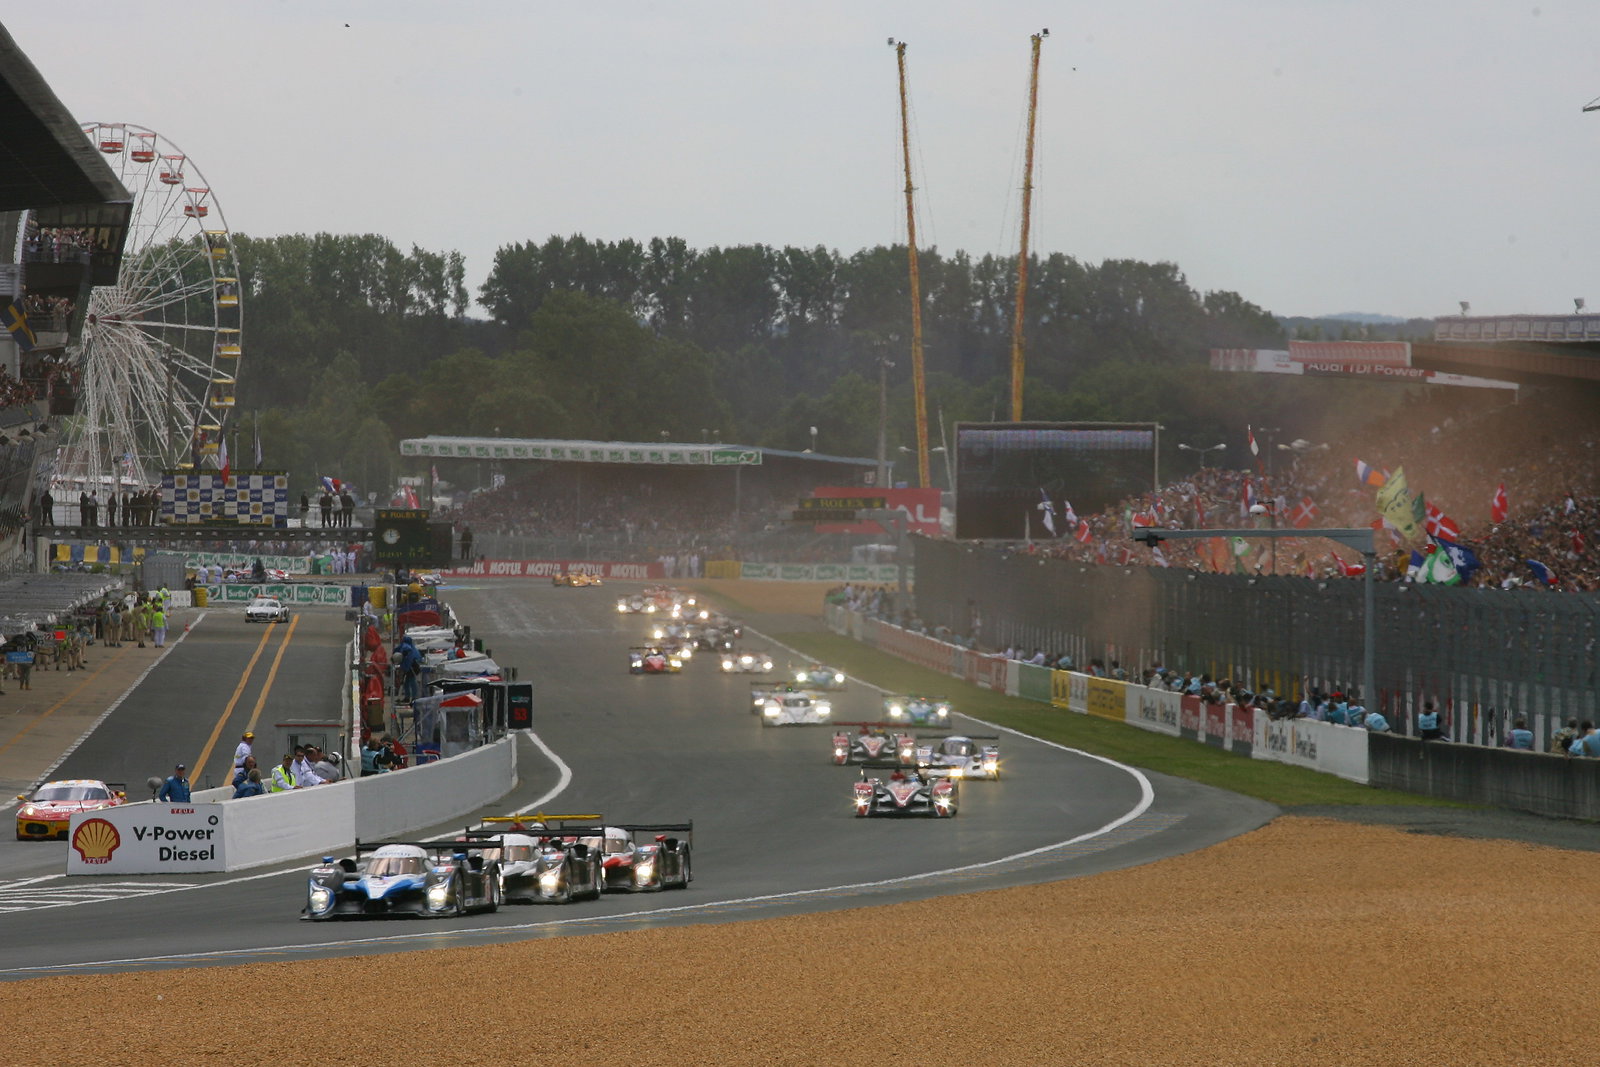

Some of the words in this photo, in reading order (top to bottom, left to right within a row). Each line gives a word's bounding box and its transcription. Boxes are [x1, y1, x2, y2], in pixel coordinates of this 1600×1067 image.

[1307, 362, 1344, 373] Audi
[1375, 365, 1424, 377] Power
[820, 499, 866, 508] ROLEX
[489, 562, 522, 575] MOTUL
[610, 565, 648, 578] MOTUL
[133, 826, 214, 841] V-Power
[159, 844, 215, 861] Diesel
